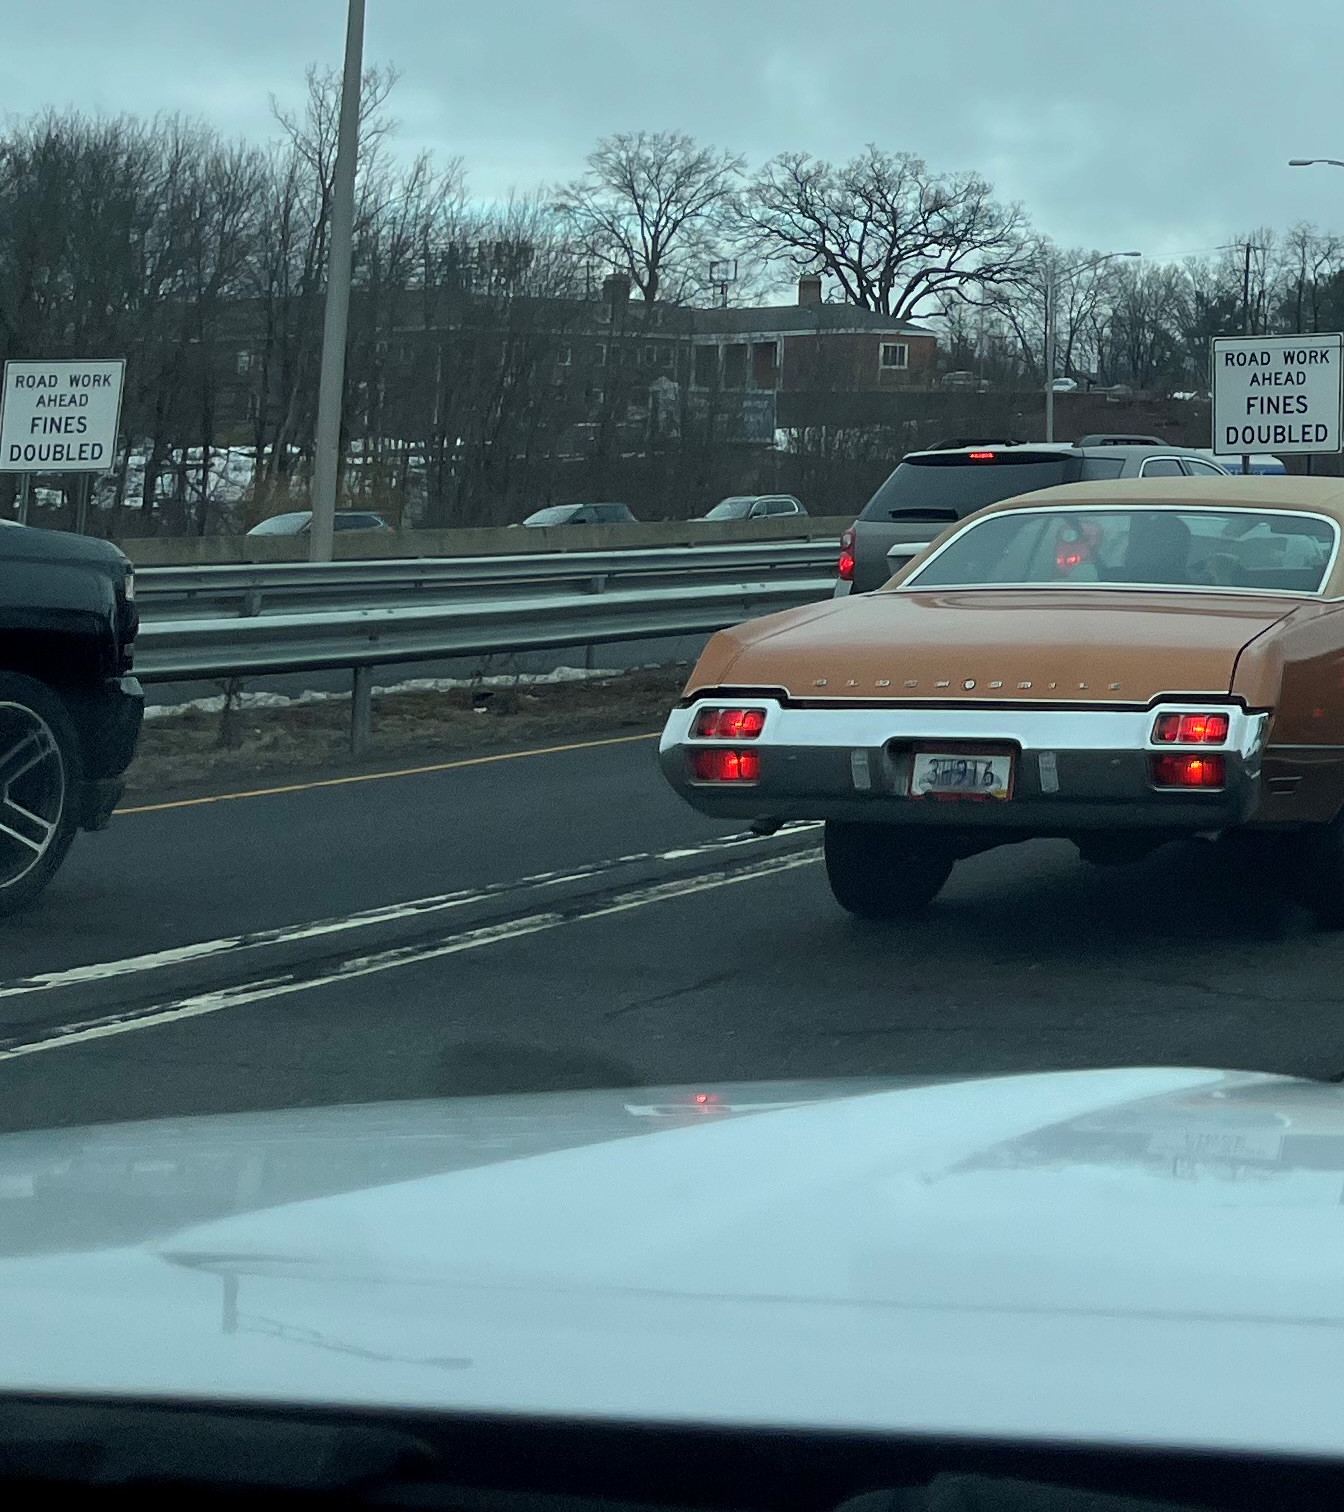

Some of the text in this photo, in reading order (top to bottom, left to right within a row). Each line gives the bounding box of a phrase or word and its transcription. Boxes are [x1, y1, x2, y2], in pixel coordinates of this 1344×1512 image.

[1225, 350, 1330, 367] ROAD WORK
[15, 373, 112, 388] ROAD WORK
[1249, 371, 1306, 386] AHEAD
[36, 394, 89, 408] AHEAD
[1246, 395, 1308, 415] FINES
[30, 416, 87, 435] FINES
[1226, 424, 1328, 445] DOUBLED
[9, 443, 103, 462] DOUBLED
